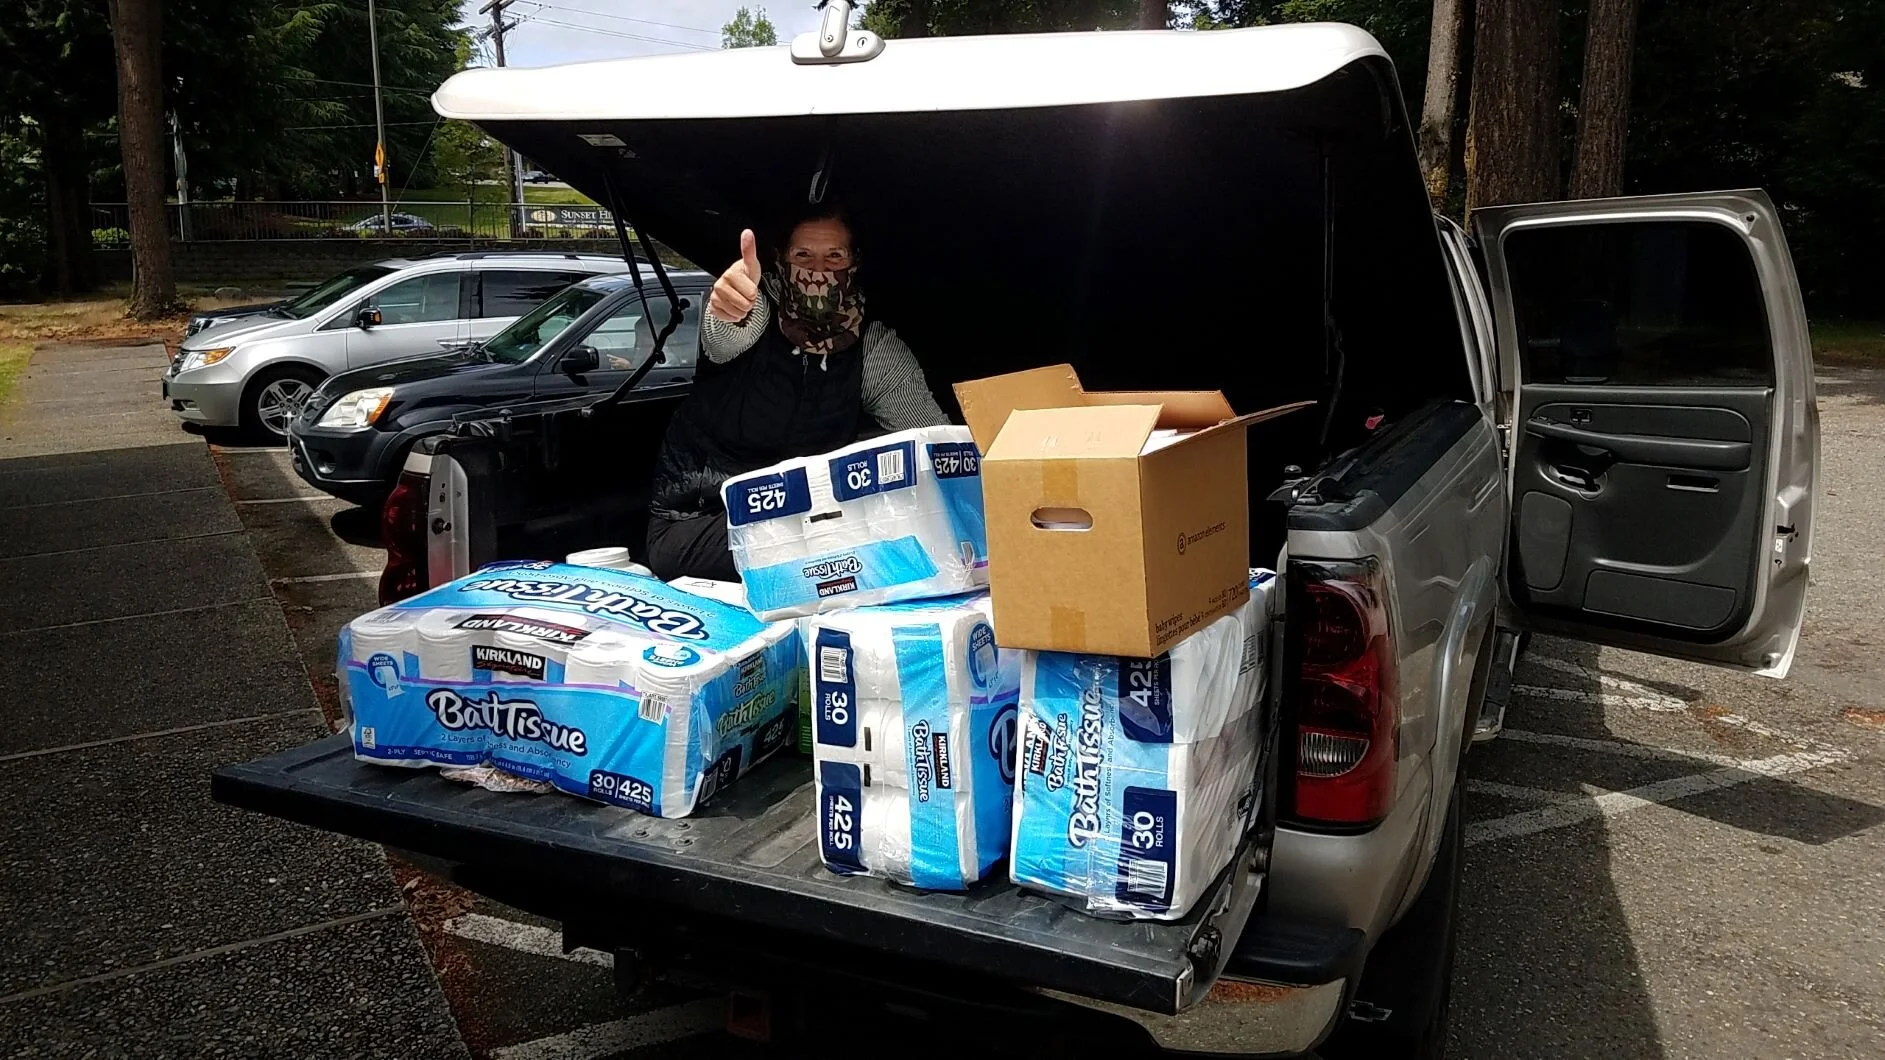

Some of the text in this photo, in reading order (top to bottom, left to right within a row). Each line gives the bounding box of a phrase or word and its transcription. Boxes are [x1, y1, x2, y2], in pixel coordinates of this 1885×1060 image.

[561, 209, 596, 219] SUNSET
[847, 459, 868, 471] ROLLS
[934, 456, 977, 475] 30 425
[847, 468, 871, 490] 30
[747, 488, 786, 513] 425
[818, 581, 855, 596] KIRKLAND
[463, 615, 575, 641] KIRKLAND
[1167, 612, 1183, 626] wipes
[972, 633, 991, 652] SHEETS
[973, 625, 987, 641] WIDE
[476, 647, 542, 669] KIRKLAND
[832, 691, 848, 725] 30
[448, 734, 475, 745] Layers
[509, 742, 525, 753] and
[435, 751, 453, 760] SAFE
[937, 735, 950, 787] KIRKLAND
[592, 773, 652, 801] 30 425
[1105, 798, 1111, 806] of
[833, 795, 852, 850] 425
[1132, 811, 1155, 850] 30
[1156, 816, 1164, 847] ROLLS
